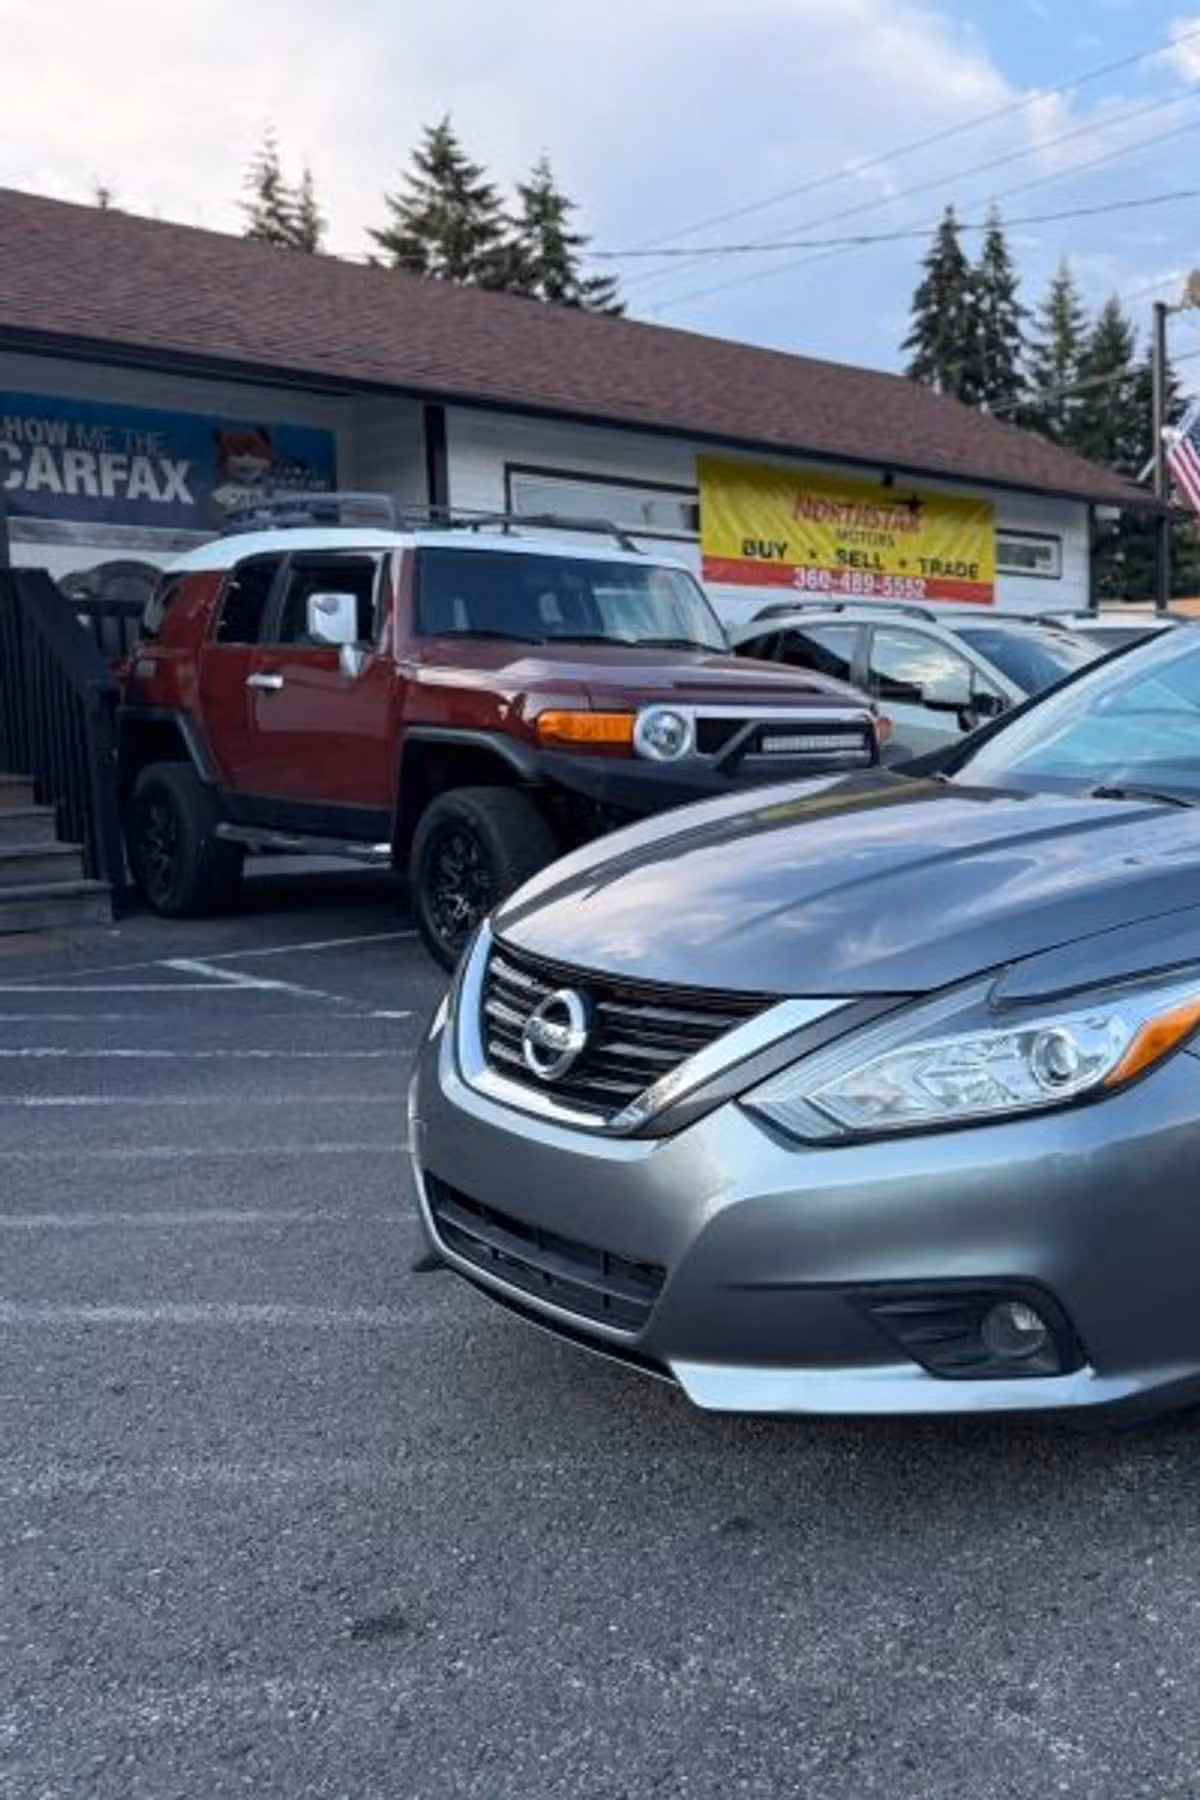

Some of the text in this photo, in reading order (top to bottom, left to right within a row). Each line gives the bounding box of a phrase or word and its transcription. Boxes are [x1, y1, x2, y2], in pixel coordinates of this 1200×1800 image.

[0, 414, 167, 457] HOW ME THE
[0, 440, 194, 504] CARFAX
[741, 539, 980, 581] BUY SELL TRADE
